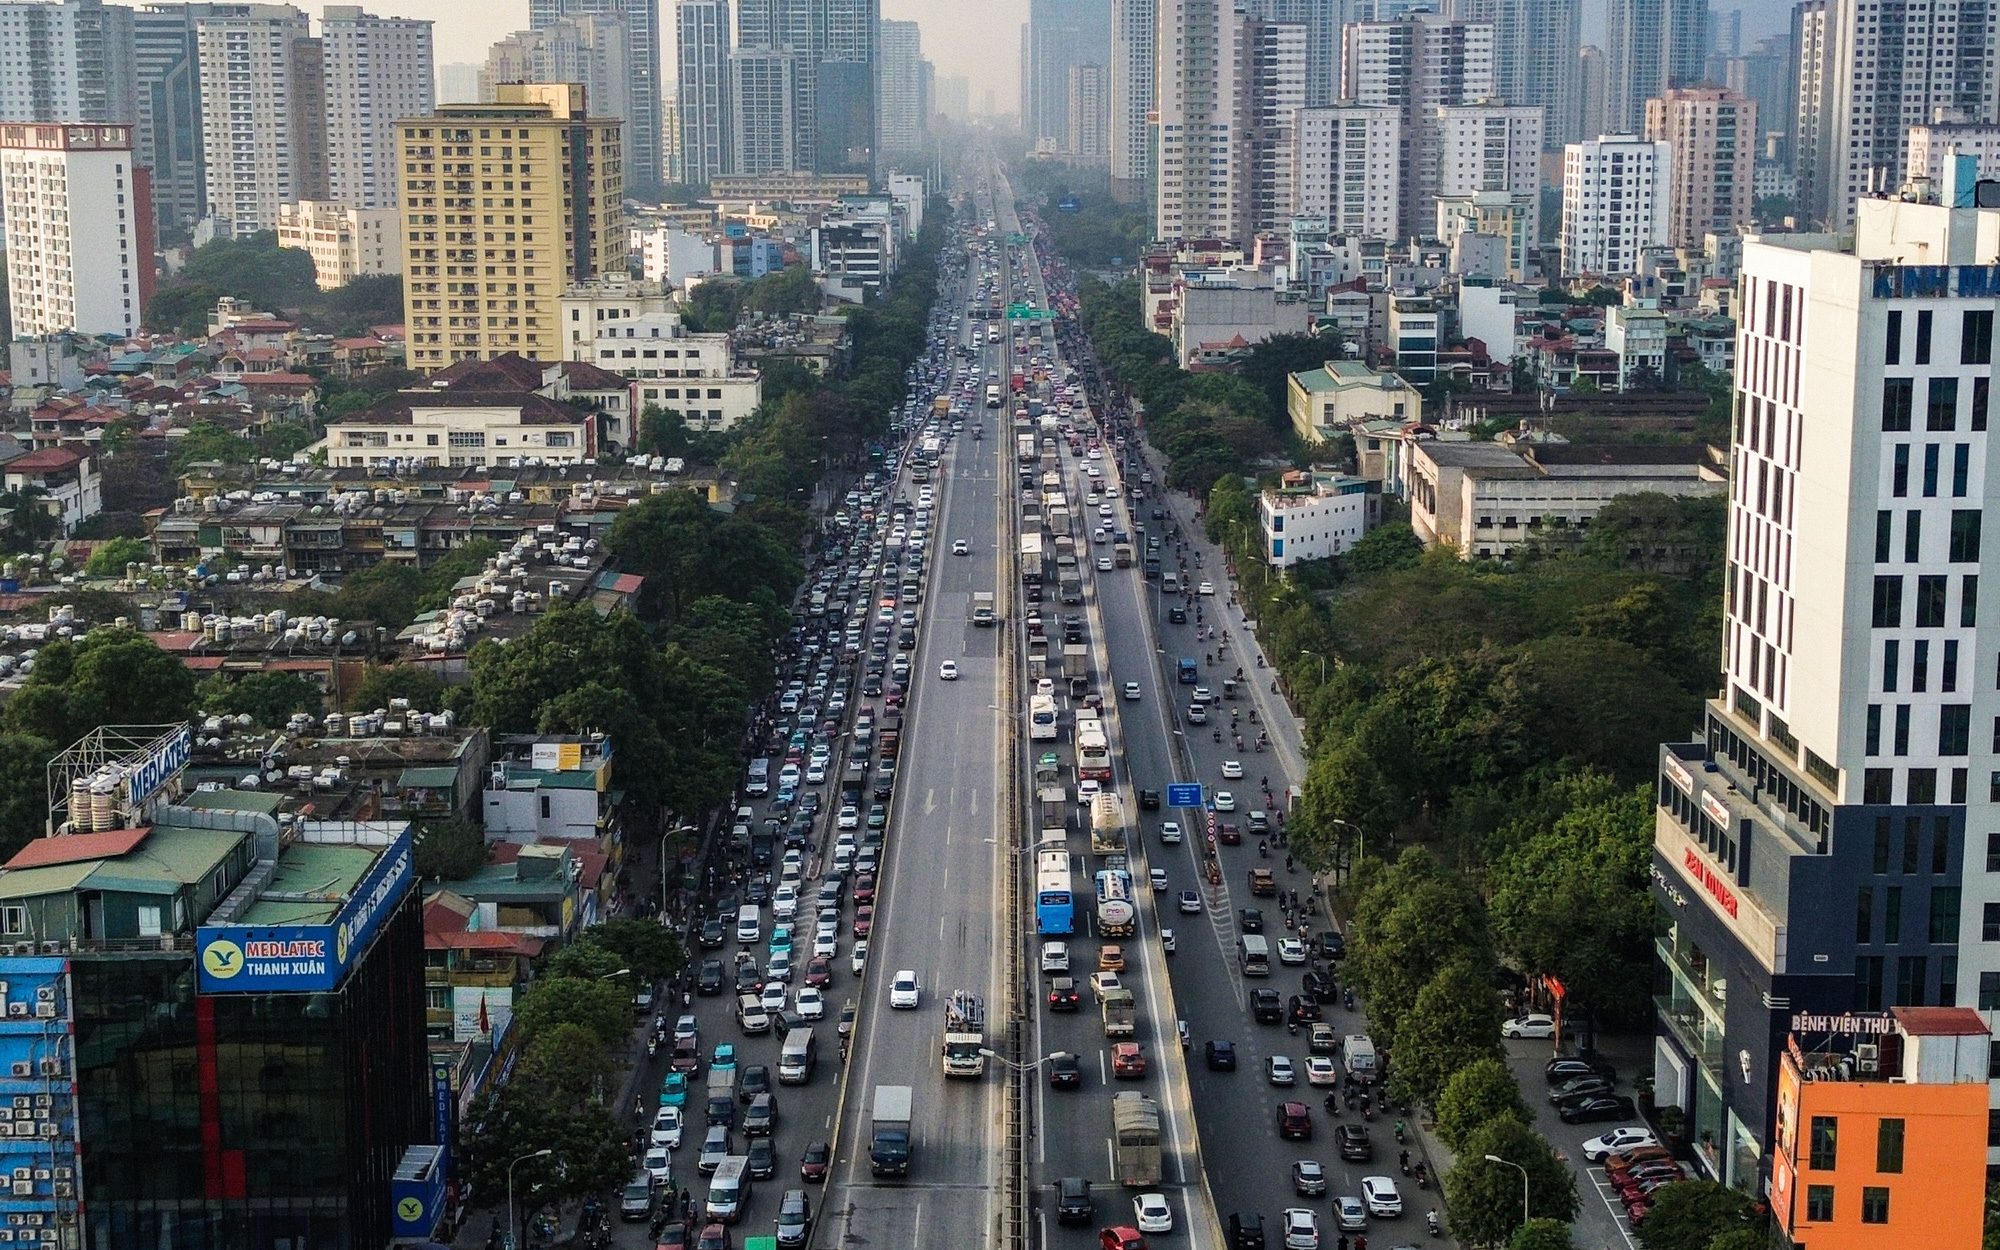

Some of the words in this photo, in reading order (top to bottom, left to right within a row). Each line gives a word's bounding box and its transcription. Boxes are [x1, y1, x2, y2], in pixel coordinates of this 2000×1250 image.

[131, 731, 191, 804] MEDLATEC
[1704, 867, 1738, 920] TOWER
[246, 941, 325, 957] MEDLATEC
[247, 963, 289, 975] THANH
[292, 960, 325, 975] XUÂN
[1792, 1010, 1827, 1036] BỆNH
[1830, 1012, 1860, 1037] VIỆN
